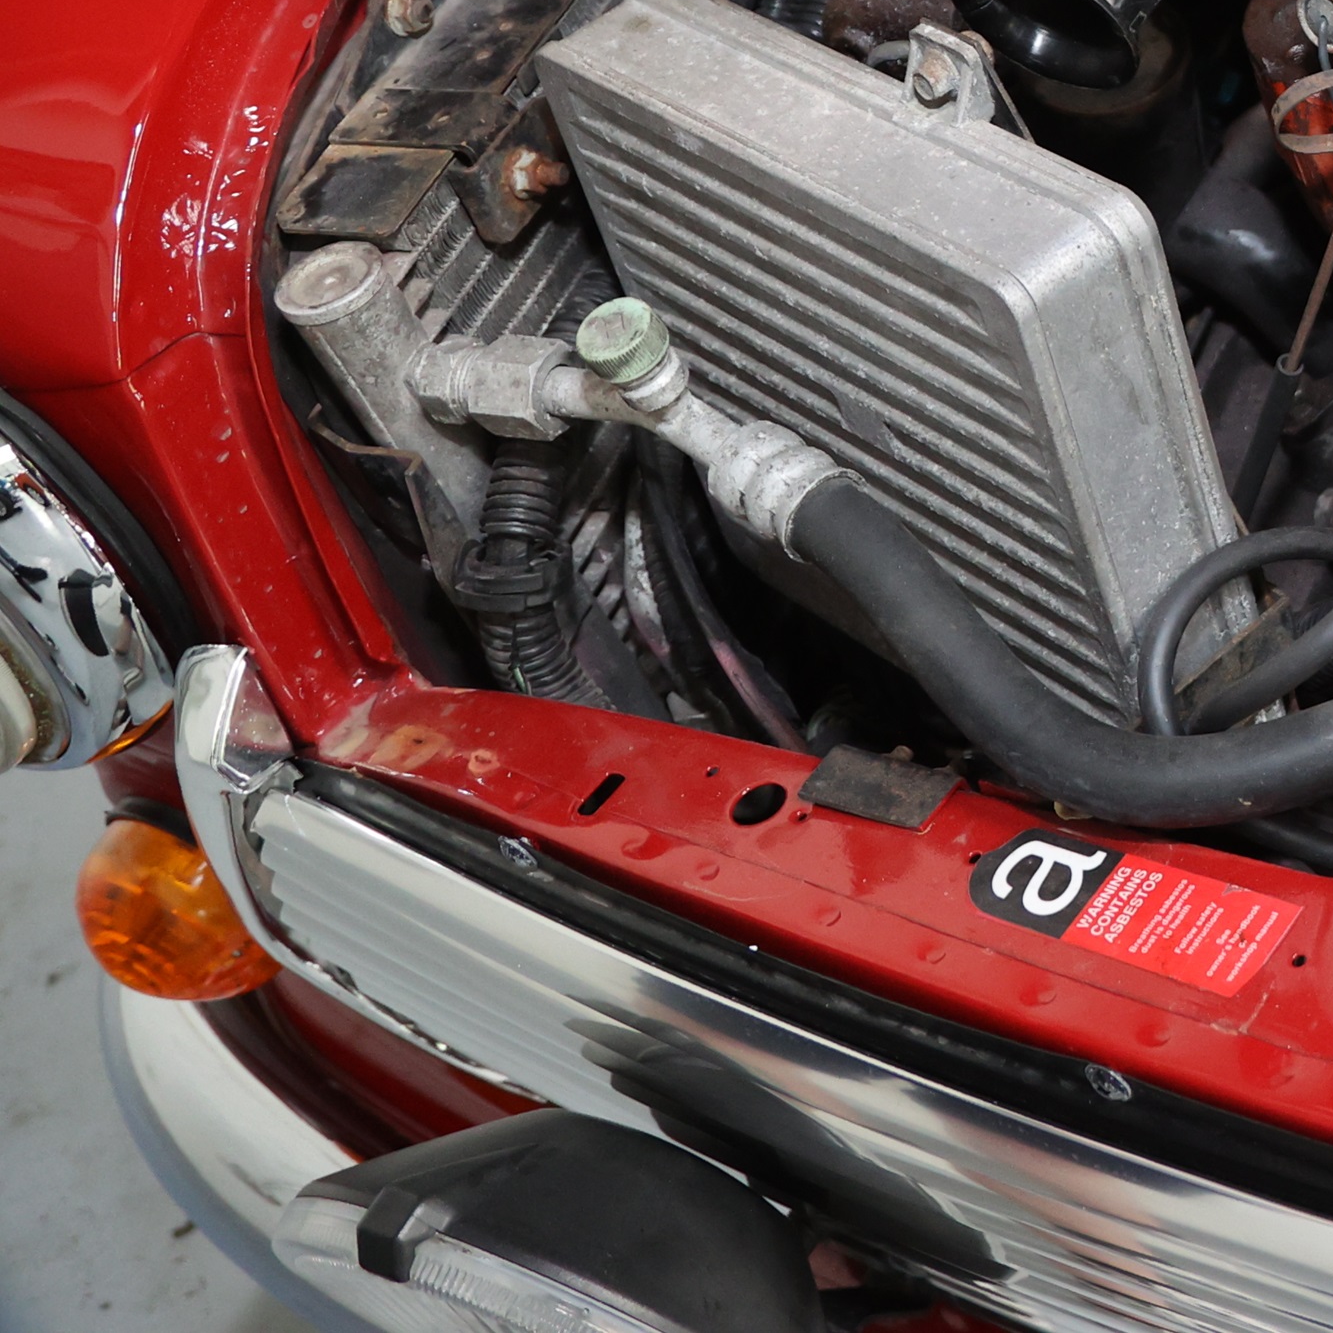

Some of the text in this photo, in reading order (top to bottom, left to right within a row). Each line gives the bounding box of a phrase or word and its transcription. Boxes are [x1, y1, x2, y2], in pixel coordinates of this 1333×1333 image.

[990, 839, 1108, 917] a
[1076, 866, 1132, 928] WARNING
[1090, 869, 1148, 936] CONTAINS
[1104, 872, 1164, 943] ASBESTOS
[1128, 879, 1188, 953] Breathing asbestos
[1141, 884, 1196, 954] dust is dangerous
[1162, 904, 1192, 939] to health
[1174, 901, 1217, 954] Follow safety
[1185, 907, 1225, 955] instructions
[1206, 904, 1261, 977] owner's handbook
[1215, 929, 1231, 945] See
[1226, 911, 1279, 982] workshop manual
